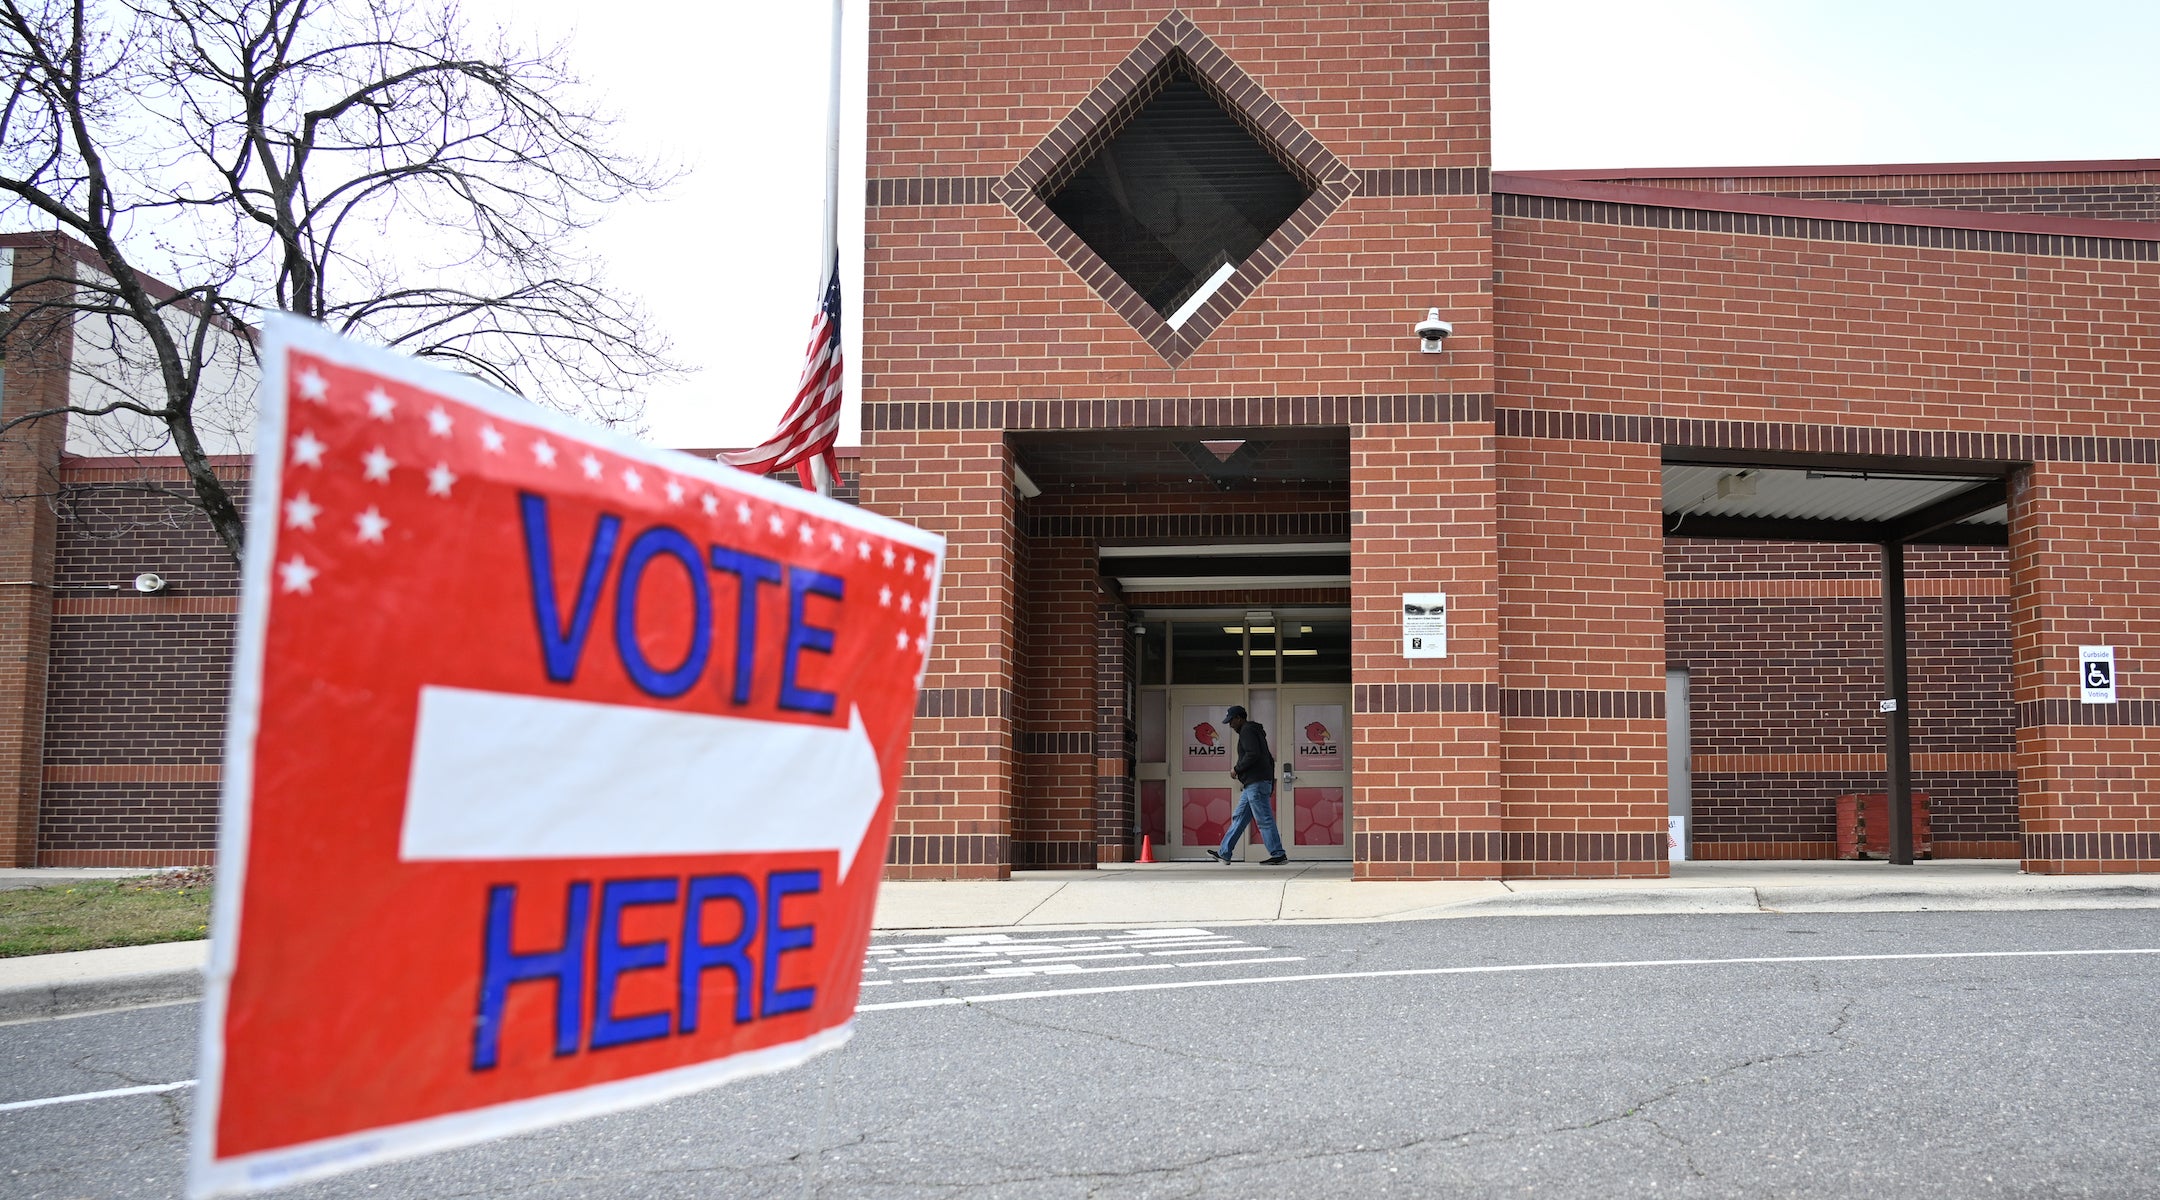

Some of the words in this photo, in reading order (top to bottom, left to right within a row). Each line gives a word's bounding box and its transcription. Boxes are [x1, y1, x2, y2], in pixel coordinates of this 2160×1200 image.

[518, 490, 845, 717] VOTE
[2088, 691, 2109, 699] Voting
[1189, 746, 1226, 755] HAHS
[1300, 745, 1337, 755] HAHS
[470, 868, 822, 1073] HERE
